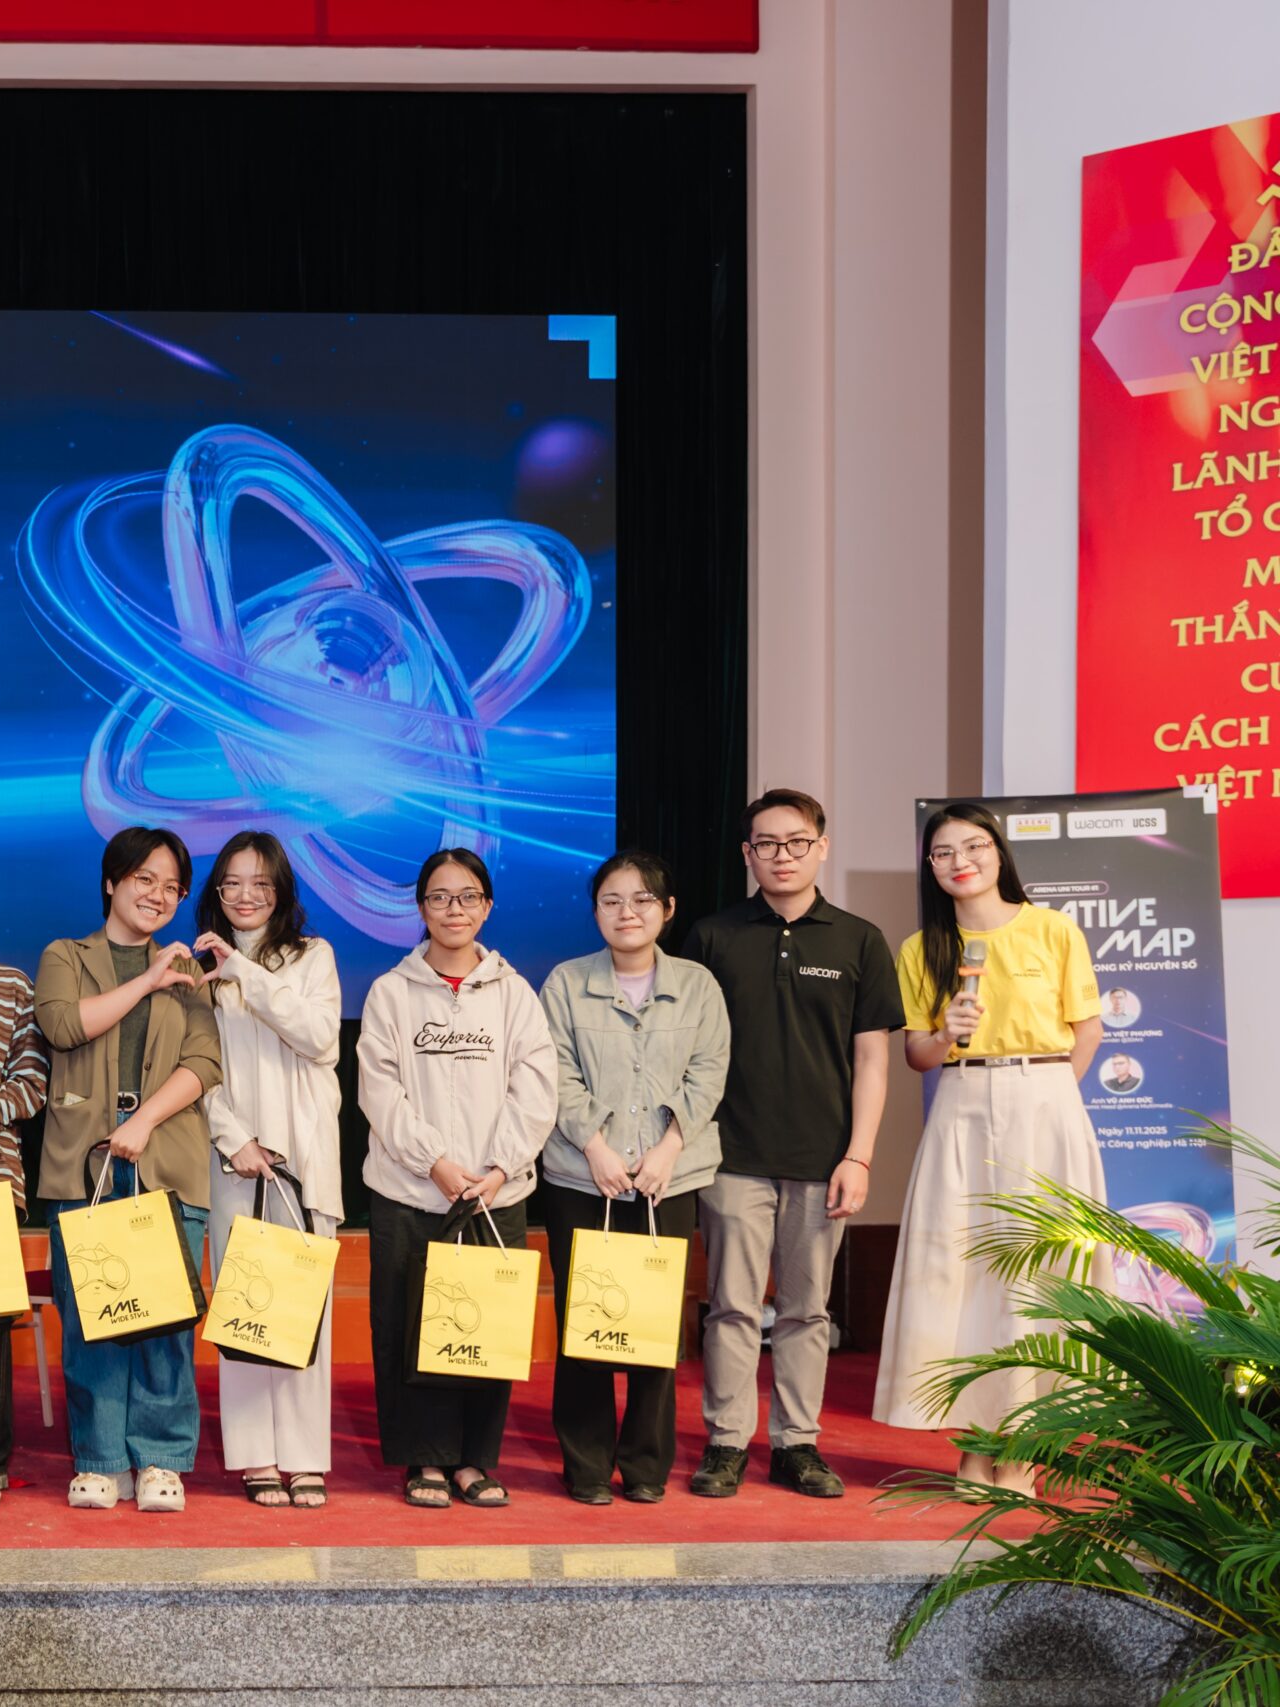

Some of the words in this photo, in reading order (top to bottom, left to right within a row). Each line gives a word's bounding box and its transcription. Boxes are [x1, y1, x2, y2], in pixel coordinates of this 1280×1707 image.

[1180, 291, 1280, 335] CỘN
[1190, 341, 1278, 385] VIỆT
[1172, 450, 1280, 492] LÃNH
[1194, 493, 1253, 540] TỔ
[1154, 713, 1270, 752] CÁCH
[1074, 818, 1124, 830] wacom
[1133, 818, 1157, 828] UCSS
[1096, 927, 1196, 959] MAP
[799, 966, 842, 980] wacom
[1135, 960, 1179, 971] NGUYÊN
[98, 1298, 140, 1321] AME
[111, 1314, 129, 1324] WIDE
[223, 1317, 267, 1338] AME
[232, 1331, 250, 1341] WIDE
[585, 1329, 629, 1346] AME
[437, 1343, 481, 1359] AME
[595, 1343, 614, 1351] WIDE
[448, 1357, 467, 1365] WIDE
